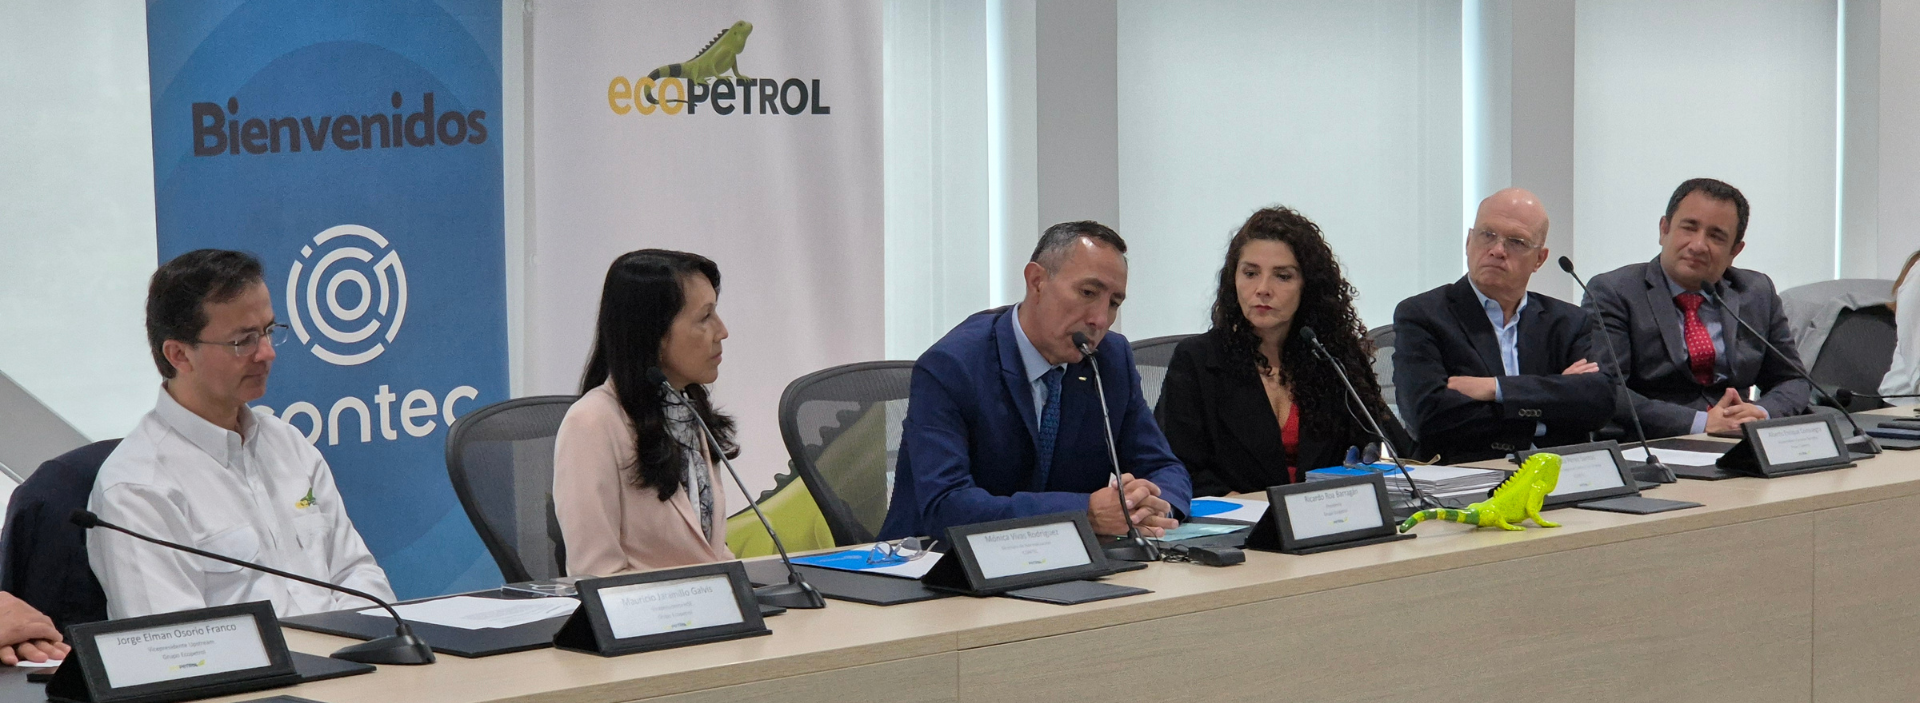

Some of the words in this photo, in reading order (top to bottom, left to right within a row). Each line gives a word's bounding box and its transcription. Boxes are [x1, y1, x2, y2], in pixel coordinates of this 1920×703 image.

[191, 91, 488, 157] Bienvenidos
[251, 384, 479, 446] ontec
[621, 594, 657, 606] Mauricio
[658, 590, 690, 601] Jaramillo
[691, 585, 713, 595] Galvis
[117, 635, 142, 646] Jorge
[143, 630, 173, 642] Elman
[174, 627, 205, 638] Osorio
[206, 623, 237, 634] Franco
